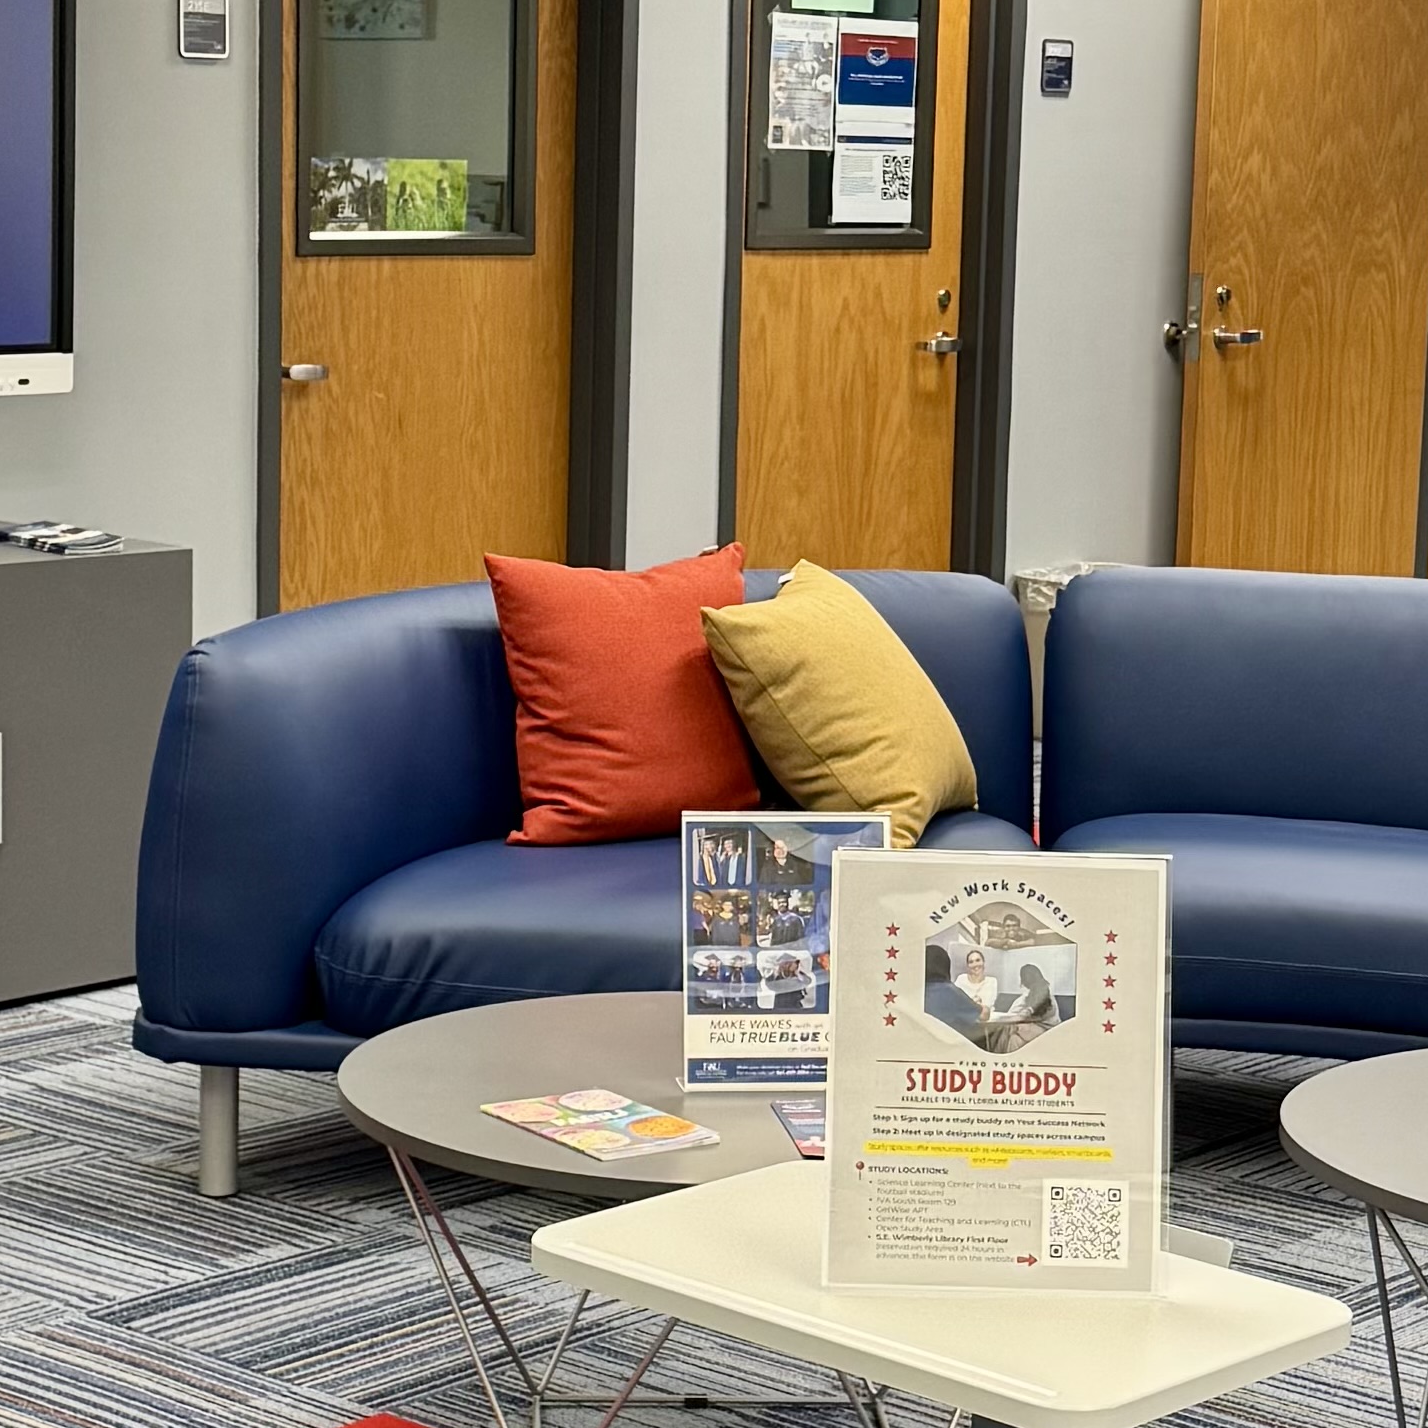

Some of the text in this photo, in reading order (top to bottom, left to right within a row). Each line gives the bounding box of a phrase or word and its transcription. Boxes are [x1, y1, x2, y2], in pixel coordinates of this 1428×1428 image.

[929, 879, 1075, 928] New Work Spaces!
[709, 1019, 792, 1029] MAKE WAVES
[709, 1032, 736, 1043] FAU
[959, 1060, 987, 1068] FIND
[906, 1067, 1076, 1097] STUDY BUDDY
[942, 1096, 951, 1104] TO
[872, 1114, 892, 1122] Step
[900, 1115, 918, 1123] Sign
[952, 1117, 974, 1125] study
[977, 1118, 1002, 1126] buddy
[872, 1127, 892, 1135] Step
[945, 1130, 991, 1138] designated
[992, 1131, 1015, 1139] study
[1017, 1132, 1044, 1140] spaces
[868, 1165, 896, 1173] STUDY
[892, 1234, 933, 1243] Wimberly
[935, 1235, 965, 1243] Library
[966, 1235, 985, 1243] First
